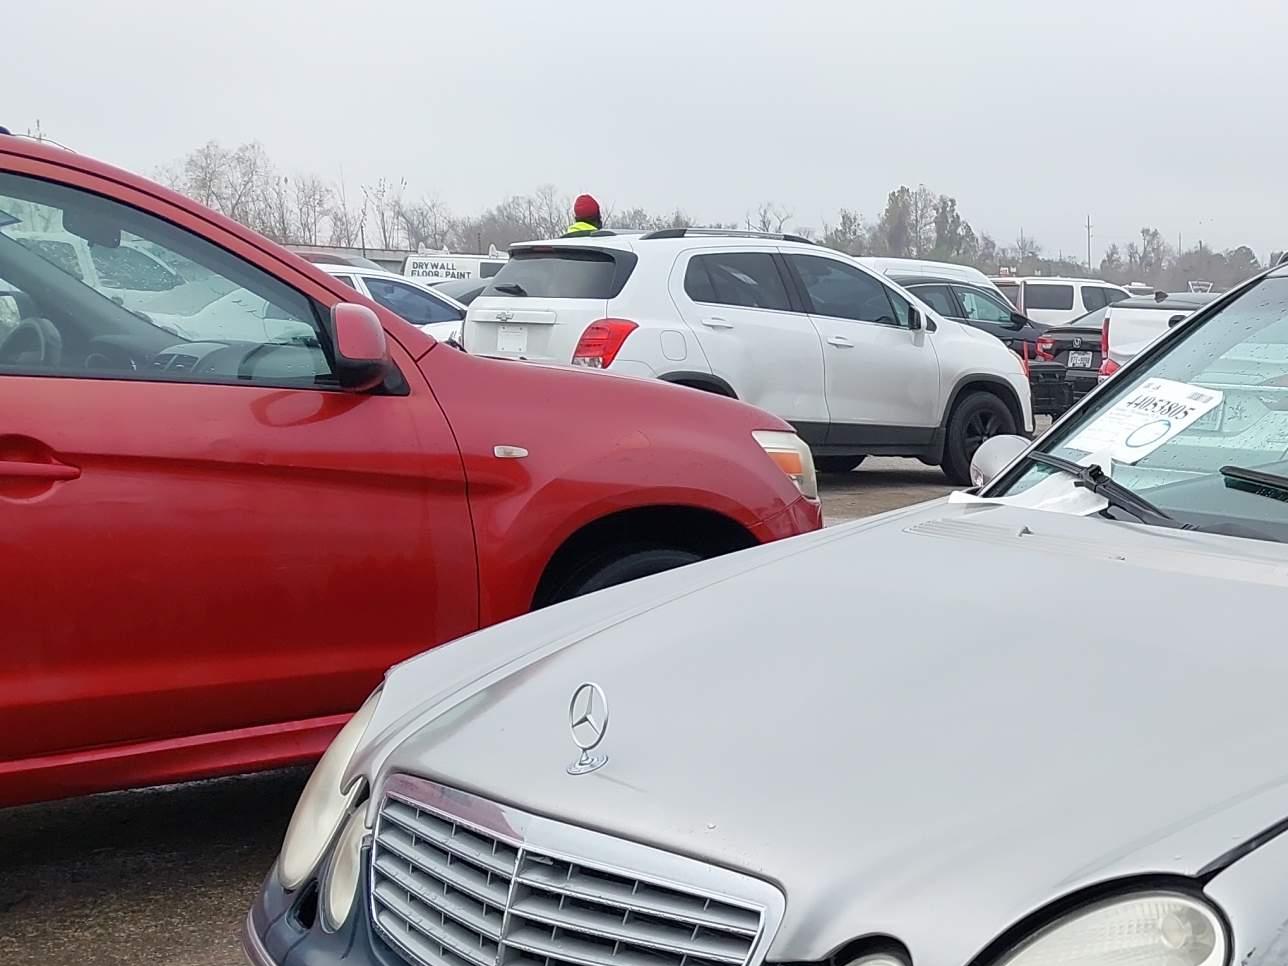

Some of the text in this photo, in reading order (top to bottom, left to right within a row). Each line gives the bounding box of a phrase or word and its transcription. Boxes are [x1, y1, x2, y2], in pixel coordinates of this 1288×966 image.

[411, 269, 440, 278] FLOOR
[445, 271, 472, 280] PAINT
[1126, 394, 1196, 420] 44053805
